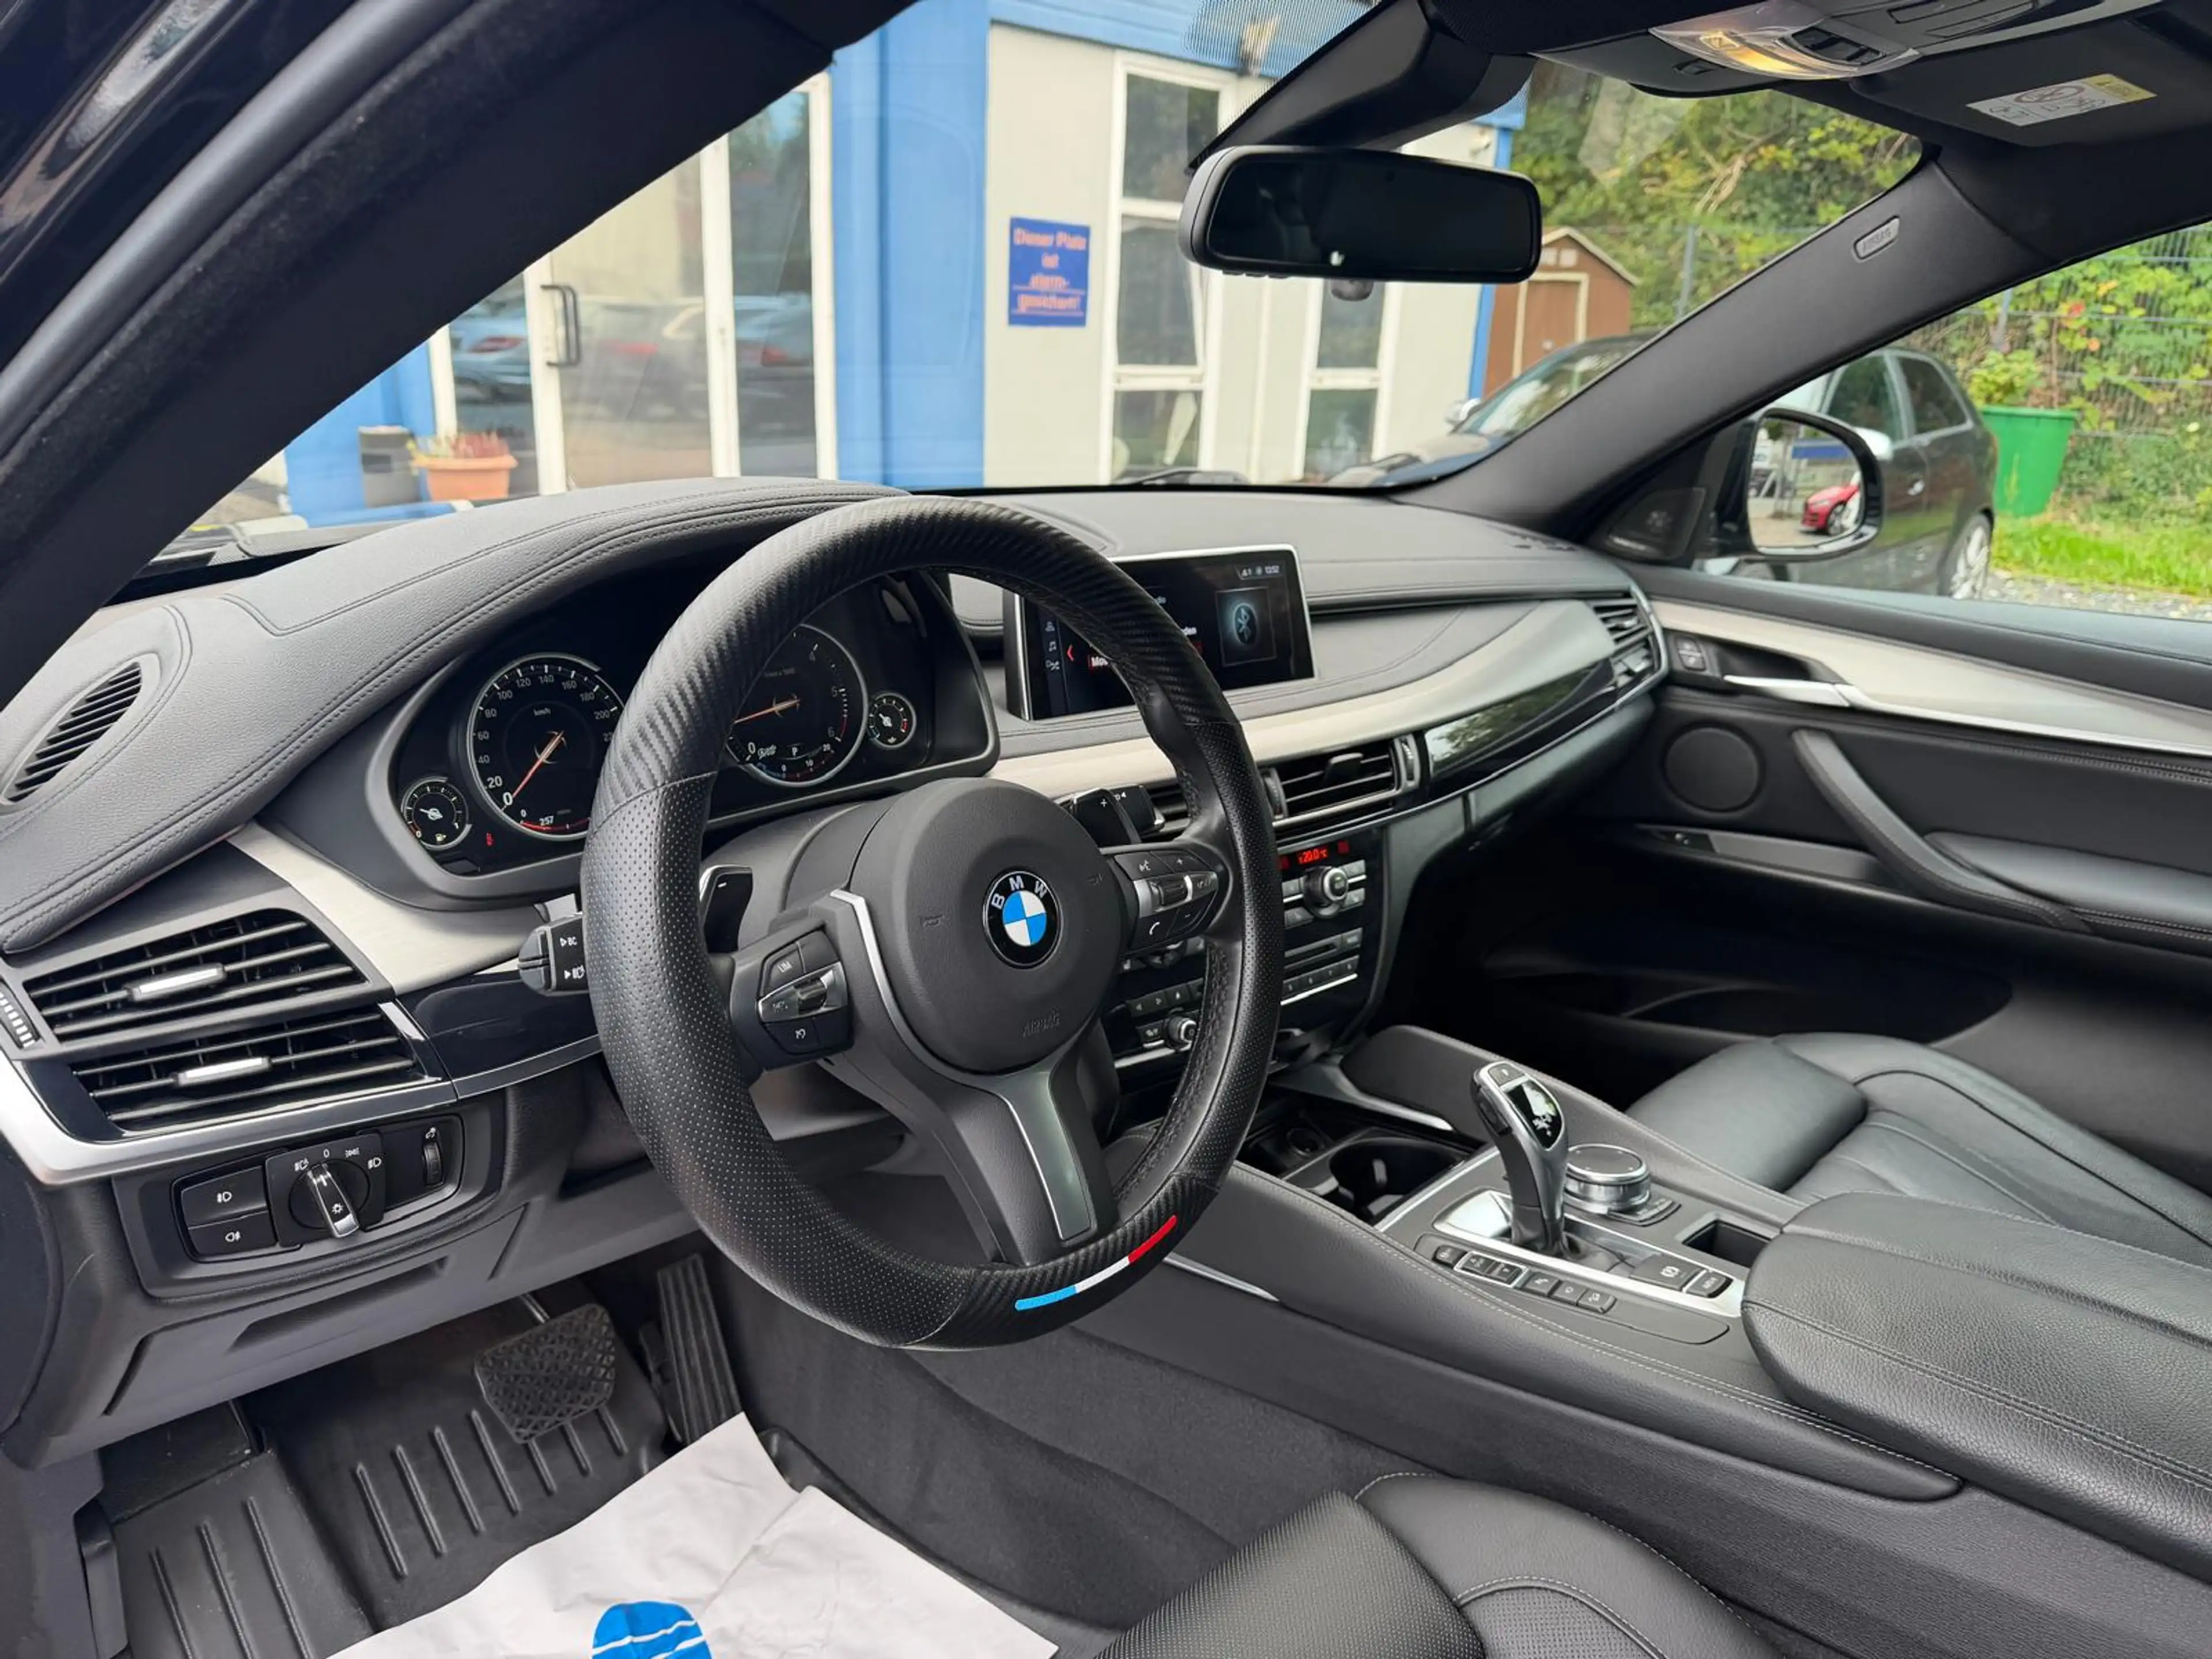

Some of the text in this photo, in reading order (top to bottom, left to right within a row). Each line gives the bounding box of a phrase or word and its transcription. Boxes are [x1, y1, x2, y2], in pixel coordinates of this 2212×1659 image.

[516, 677, 532, 687] 120
[539, 675, 554, 684] 140
[561, 680, 577, 690] 160
[497, 691, 513, 700] 100
[484, 708, 497, 718] 80
[593, 709, 611, 720] 200
[478, 730, 490, 741] 60
[748, 743, 756, 754] 0
[478, 755, 490, 764] 40
[487, 775, 502, 789] 20
[503, 792, 513, 805] 0
[521, 809, 527, 817] 0
[539, 816, 554, 826] 257
[991, 875, 1048, 910] BMW
